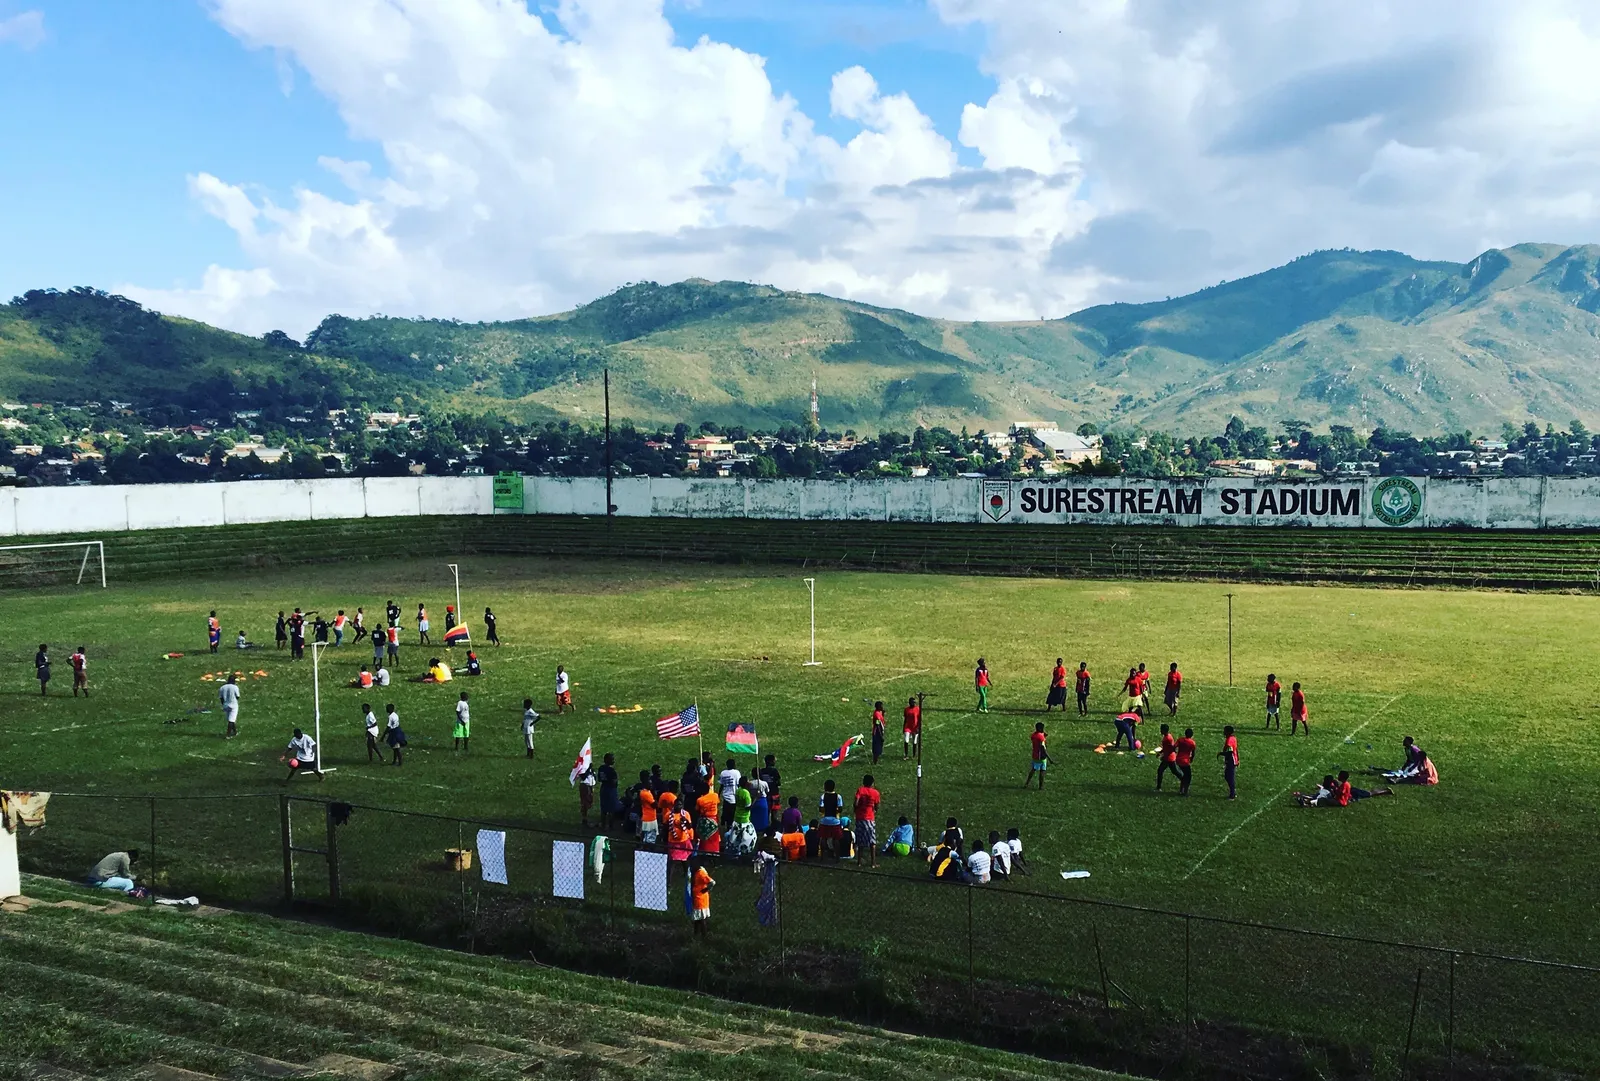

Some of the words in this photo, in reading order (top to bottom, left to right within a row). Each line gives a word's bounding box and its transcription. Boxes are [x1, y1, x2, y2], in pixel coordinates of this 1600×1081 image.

[1379, 479, 1417, 494] SURESTREAM
[1020, 488, 1202, 514] SURESTREAM
[1220, 488, 1360, 515] STADIUM
[1374, 503, 1397, 524] FOOTBALL
